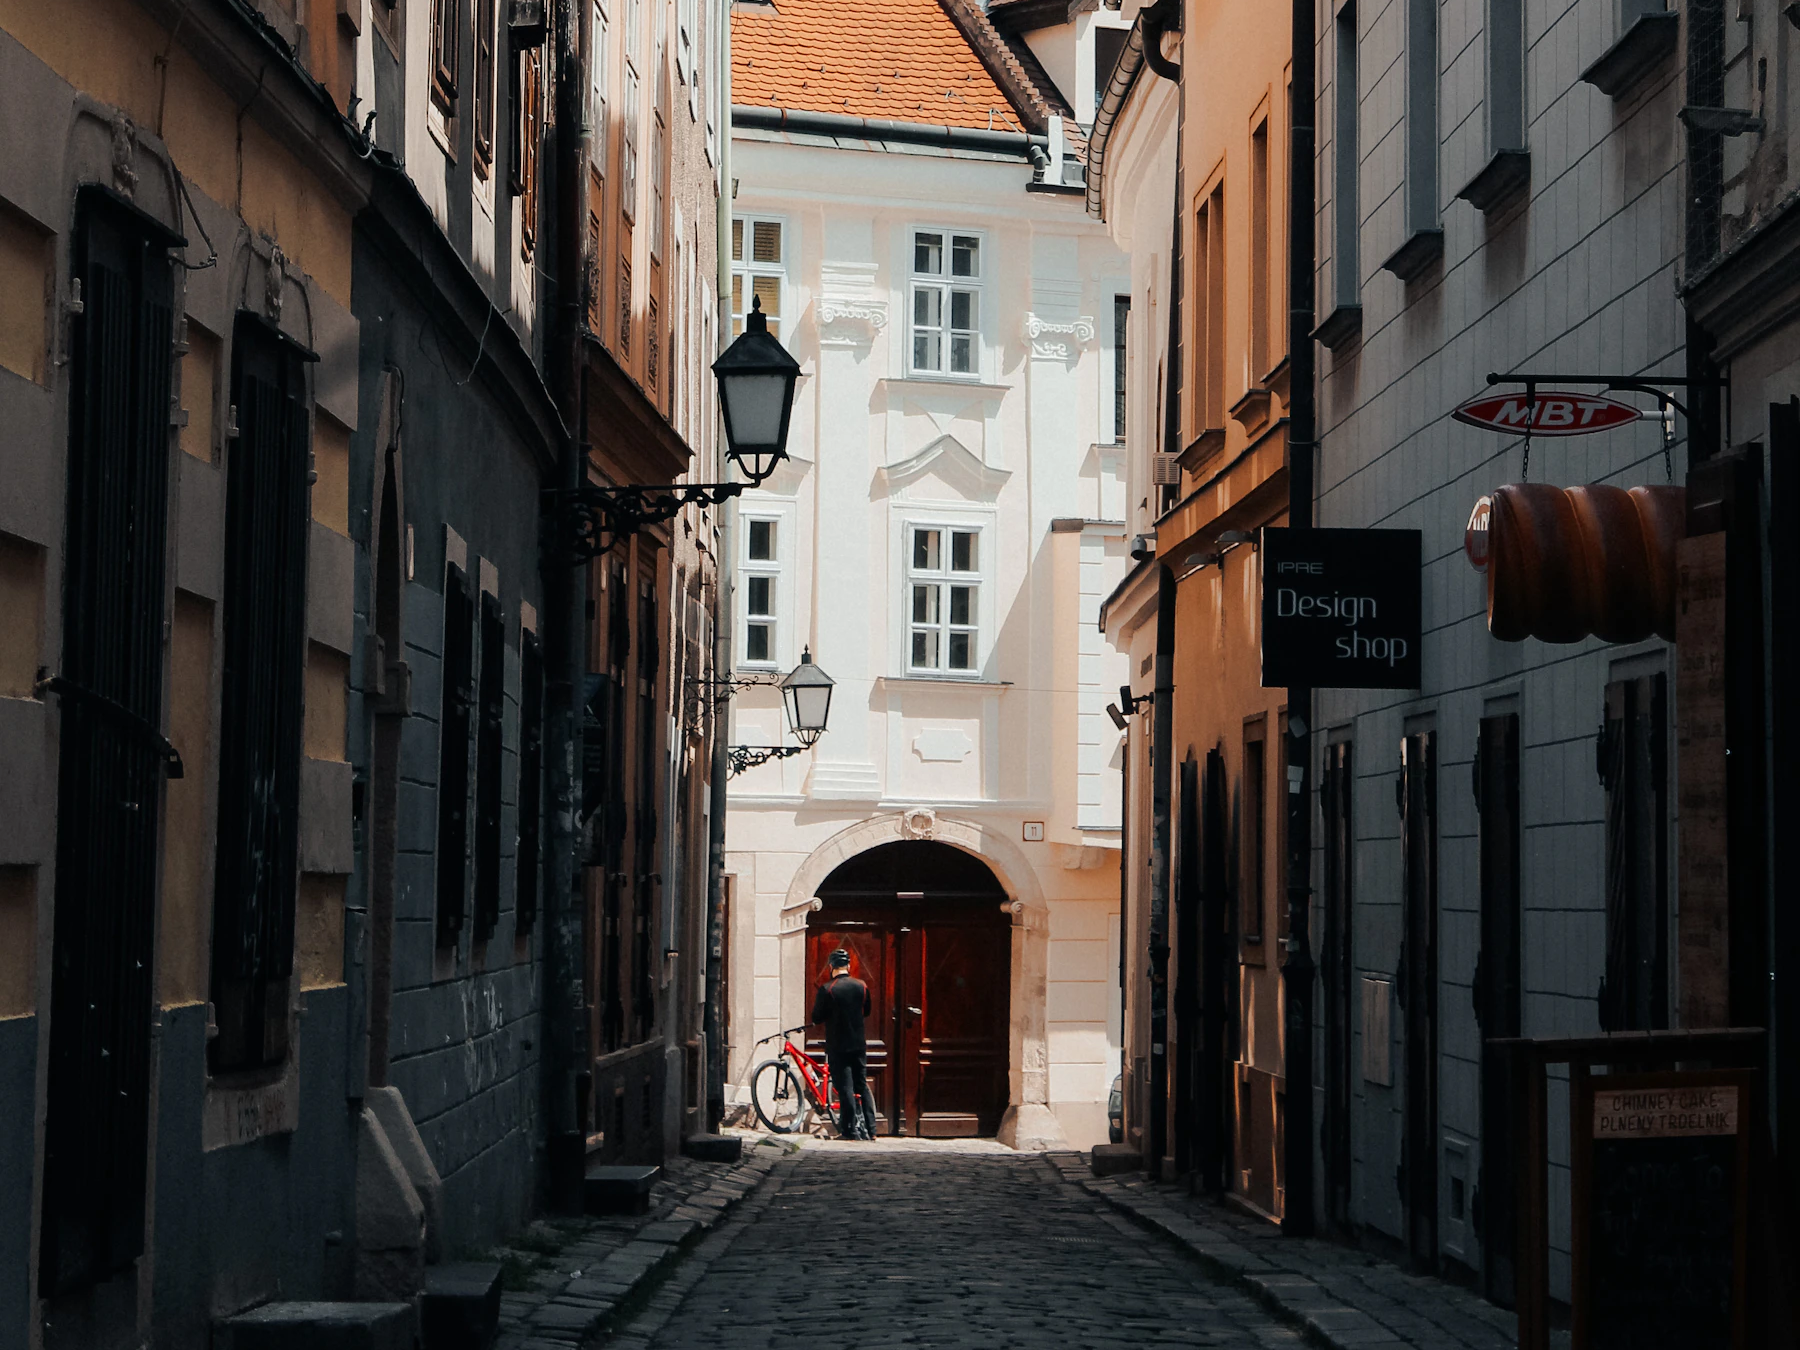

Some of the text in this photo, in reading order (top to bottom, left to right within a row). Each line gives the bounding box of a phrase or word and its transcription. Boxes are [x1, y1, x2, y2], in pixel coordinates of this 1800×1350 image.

[1492, 401, 1609, 426] MBT
[1277, 588, 1377, 626] Design
[1335, 630, 1407, 667] shop
[1613, 1093, 1717, 1112] CHIMNEY CAKE
[1601, 1109, 1729, 1132] PLNENÝ TRDELNÍK
